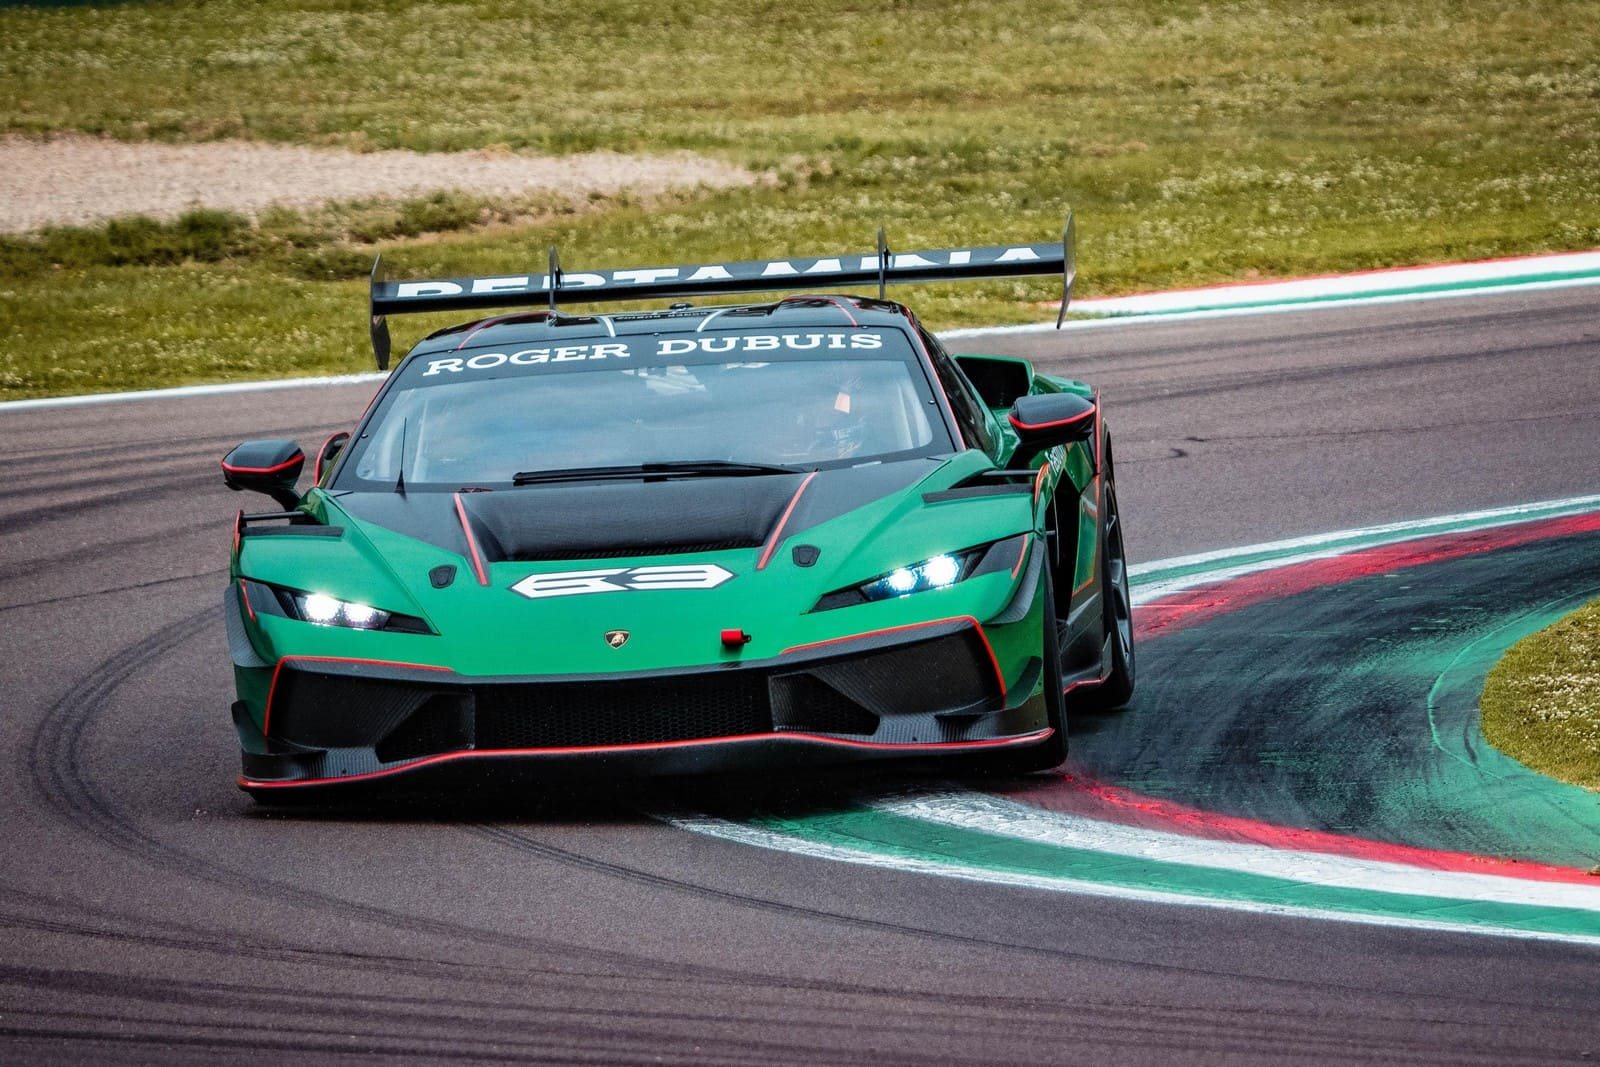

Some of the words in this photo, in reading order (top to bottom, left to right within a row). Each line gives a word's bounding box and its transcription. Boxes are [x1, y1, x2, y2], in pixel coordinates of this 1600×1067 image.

[422, 343, 631, 377] ROGER
[656, 333, 883, 355] DUBUIS
[508, 563, 738, 599] 63
